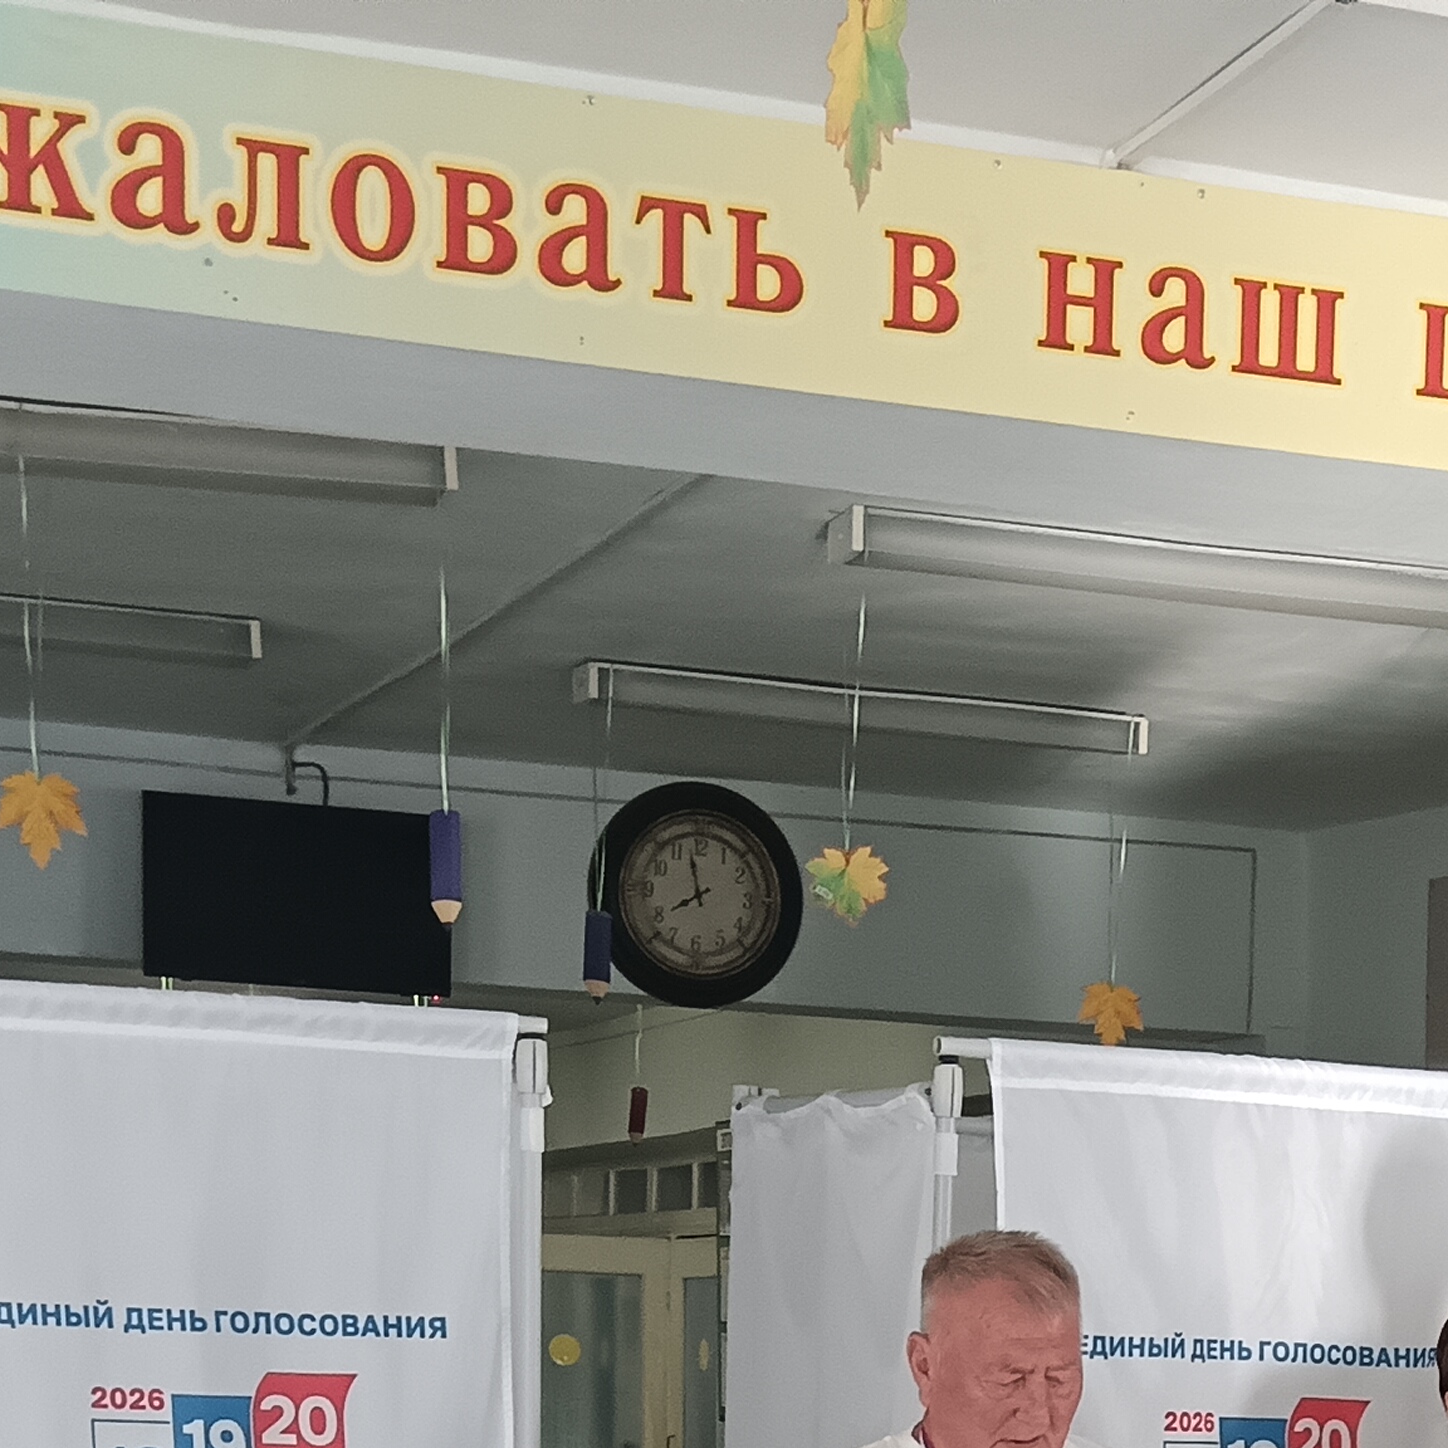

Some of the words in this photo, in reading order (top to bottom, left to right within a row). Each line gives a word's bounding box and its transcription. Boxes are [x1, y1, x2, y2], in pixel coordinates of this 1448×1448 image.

[882, 228, 962, 335] в
[1035, 248, 1344, 388] наш
[694, 837, 709, 857] 12
[735, 866, 746, 885] 2
[123, 1304, 208, 1335] ДЕНЬ
[214, 1309, 449, 1340] ГОЛОСОВАНИЯ
[1190, 1338, 1254, 1364] ДЕНЬ
[1259, 1340, 1436, 1369] ГОЛОСОВАНИЯ
[90, 1386, 166, 1412] 2026
[259, 1394, 339, 1448] 20
[1163, 1410, 1215, 1433] 2026
